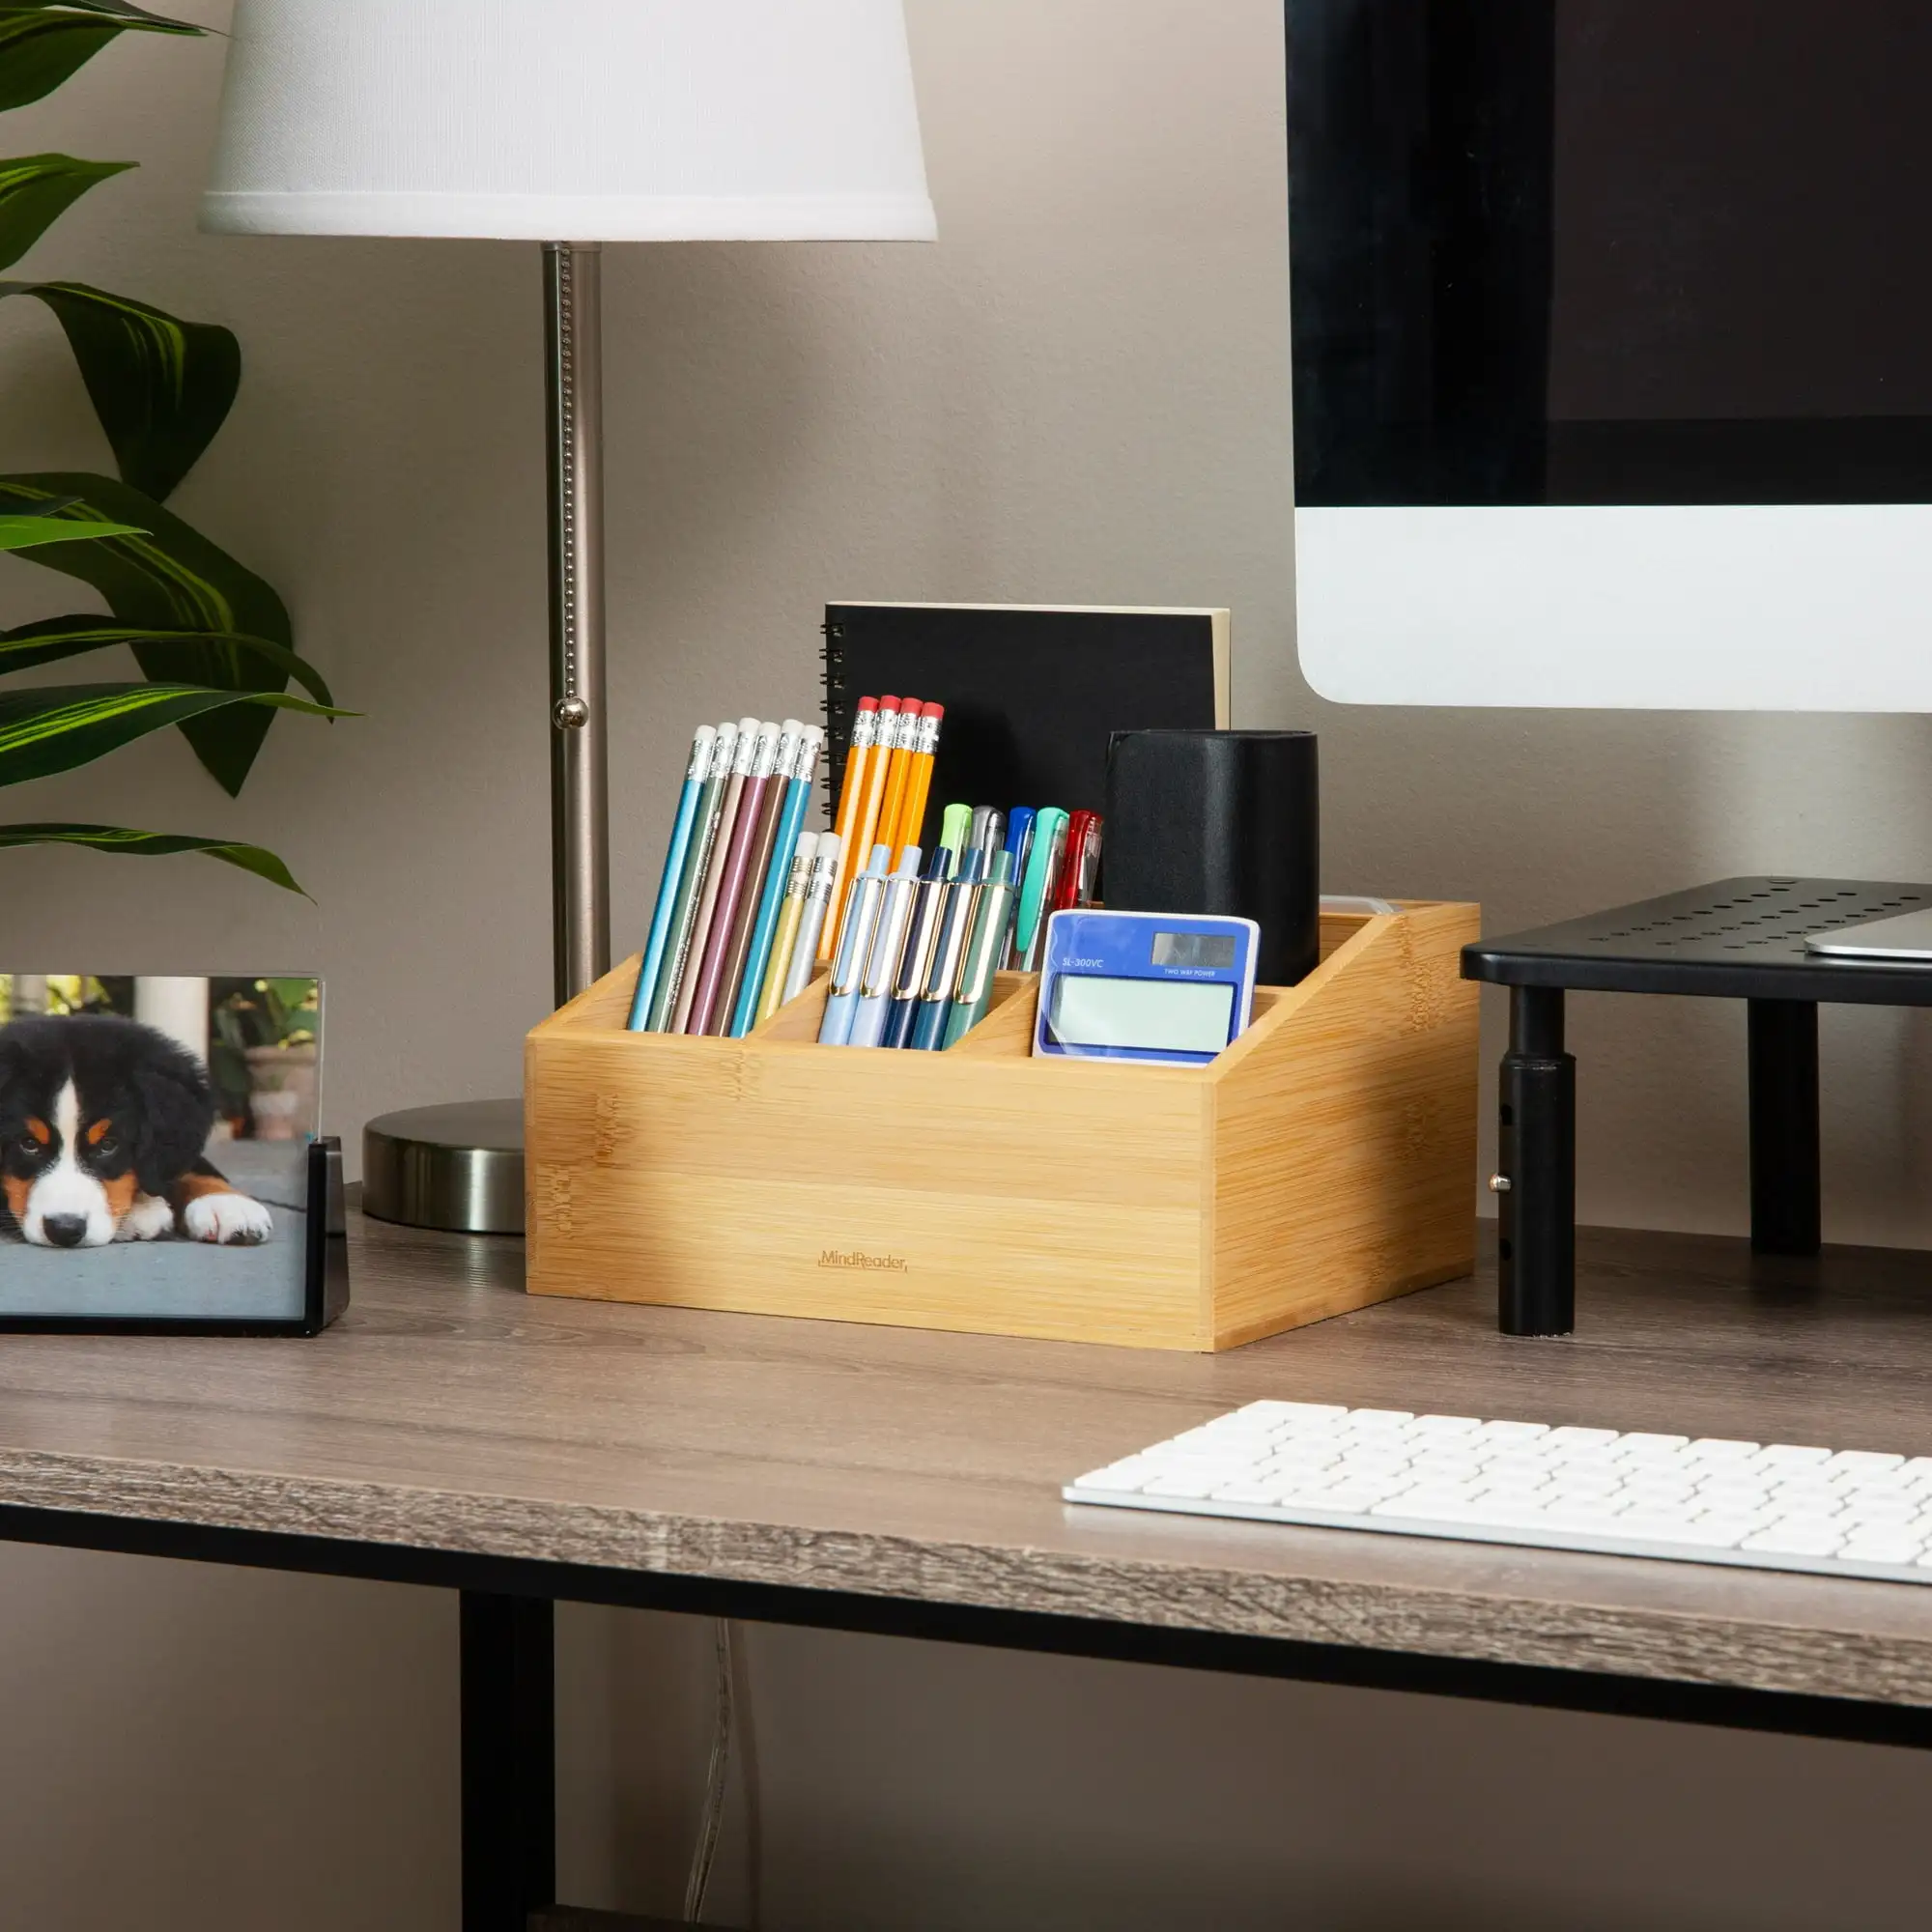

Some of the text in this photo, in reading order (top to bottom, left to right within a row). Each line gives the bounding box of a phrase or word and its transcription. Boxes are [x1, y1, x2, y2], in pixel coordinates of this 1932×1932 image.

[1062, 957, 1104, 968] SL-300VC
[1194, 969, 1215, 978] POWER
[820, 1250, 906, 1271] MindReader
